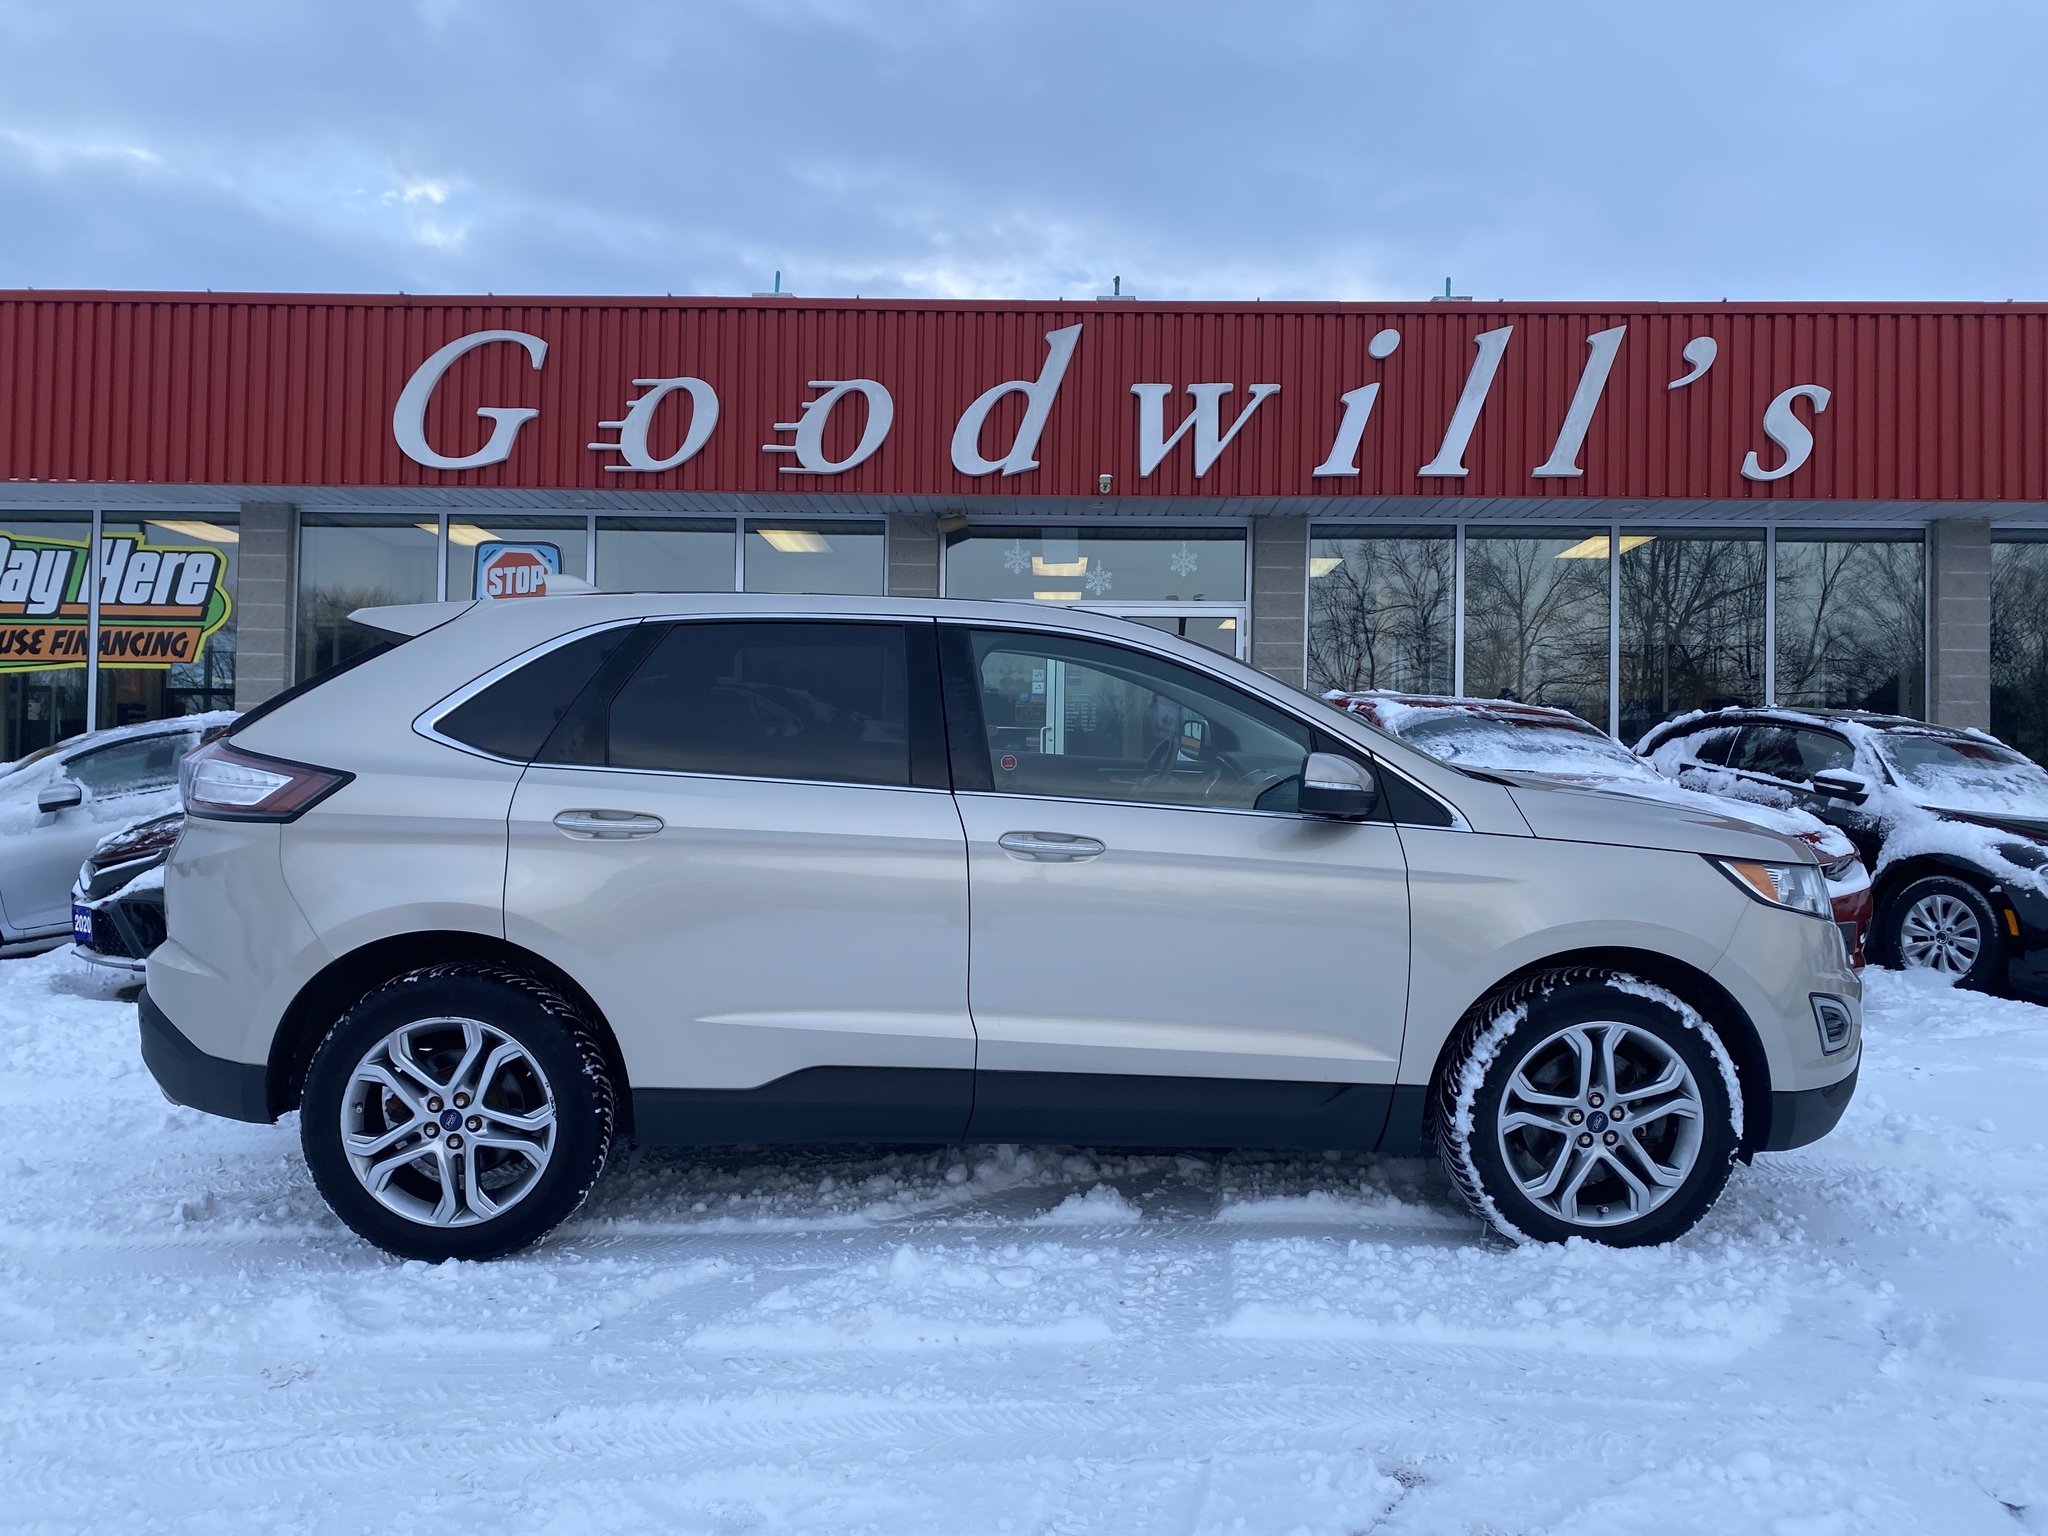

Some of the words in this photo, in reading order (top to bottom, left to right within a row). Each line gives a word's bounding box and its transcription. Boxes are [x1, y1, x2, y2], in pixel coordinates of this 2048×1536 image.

[392, 323, 1832, 482] Goodwill's
[0, 537, 71, 614] ay
[77, 539, 216, 605] Here
[488, 564, 545, 596] STOP
[49, 629, 190, 658] FINANCING
[74, 914, 91, 934] 2020
